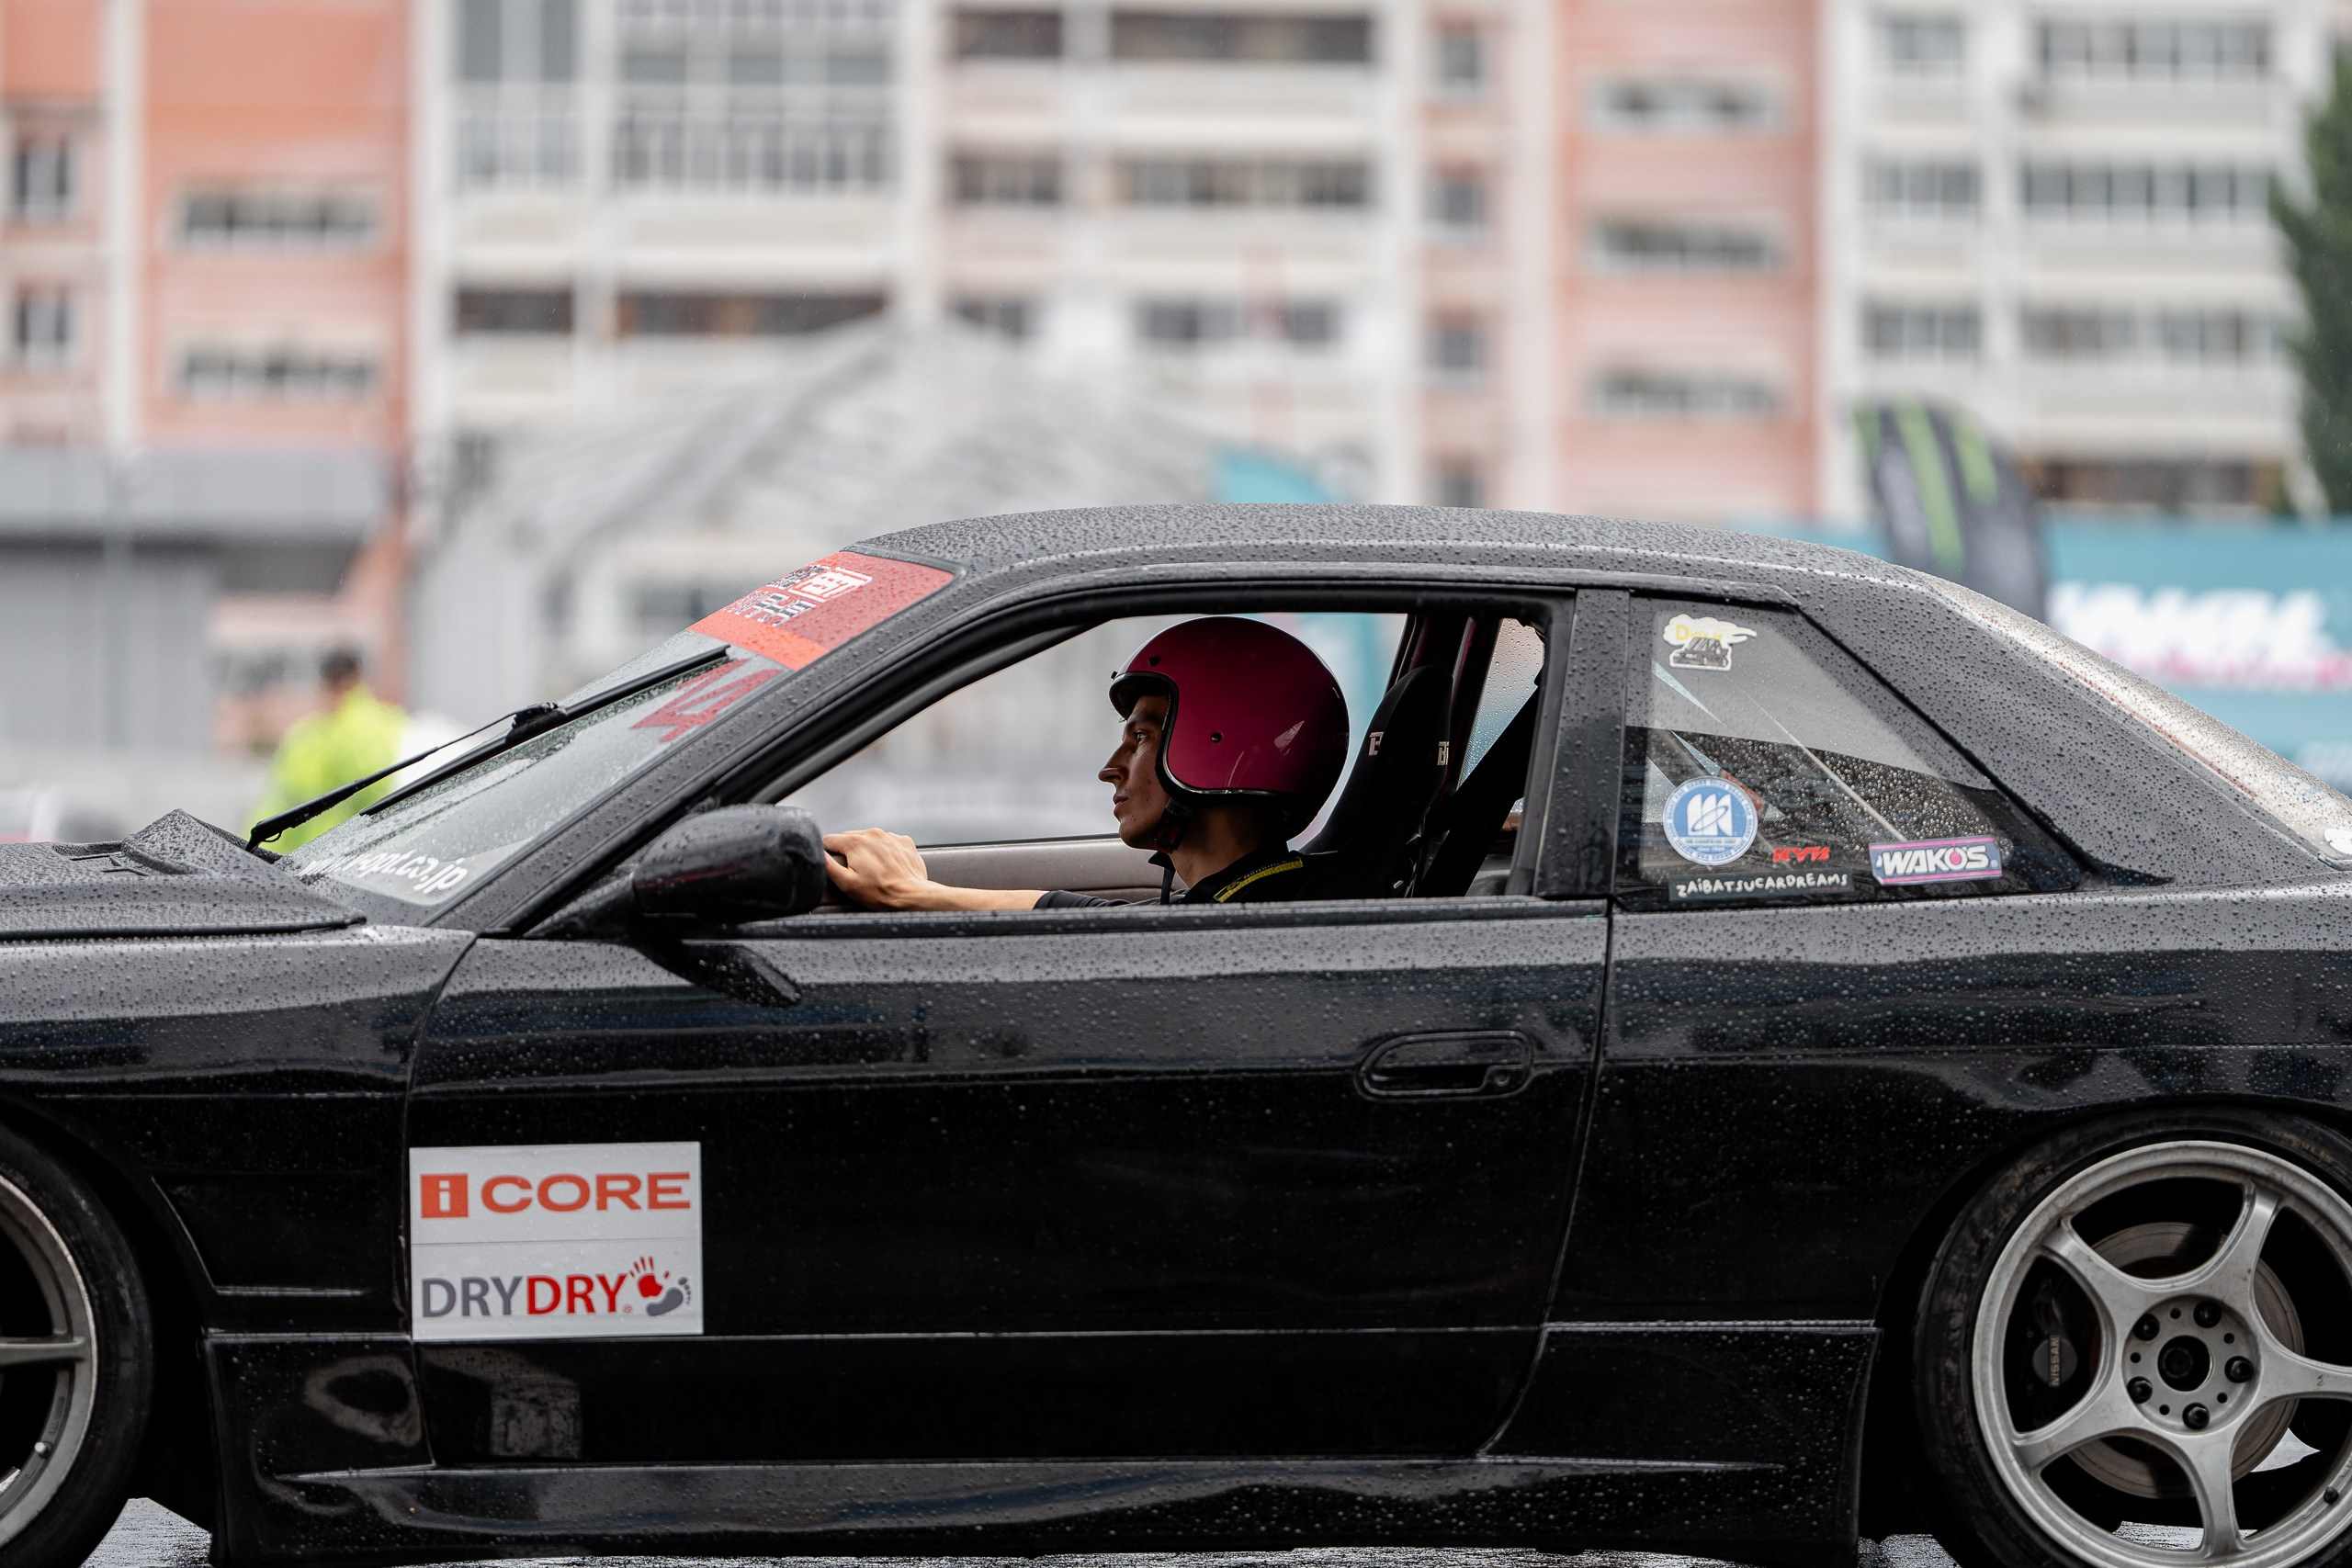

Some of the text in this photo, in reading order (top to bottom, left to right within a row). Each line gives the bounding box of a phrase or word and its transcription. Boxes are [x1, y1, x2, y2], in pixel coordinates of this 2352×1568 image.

[1773, 845, 1831, 863] KYB
[481, 1171, 692, 1213] CORE
[421, 1273, 628, 1318] DRYDRY
[2050, 1336, 2061, 1387] NISSAN
